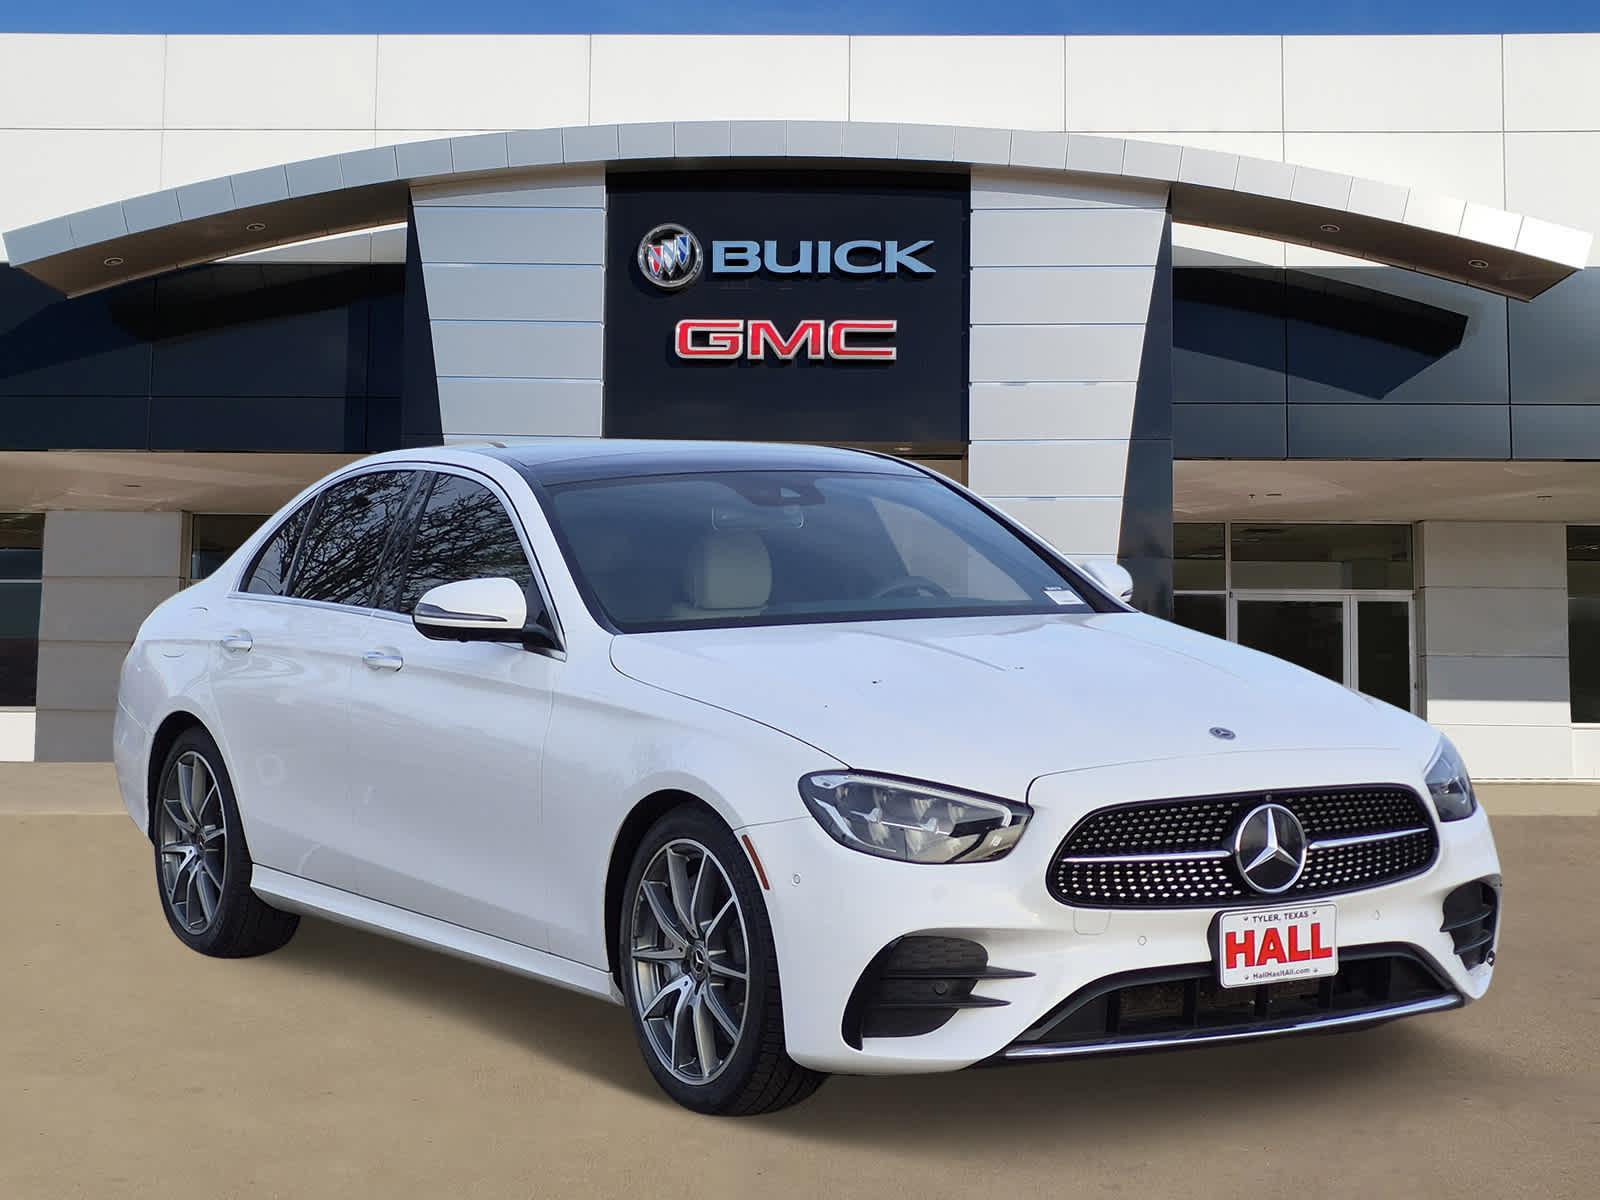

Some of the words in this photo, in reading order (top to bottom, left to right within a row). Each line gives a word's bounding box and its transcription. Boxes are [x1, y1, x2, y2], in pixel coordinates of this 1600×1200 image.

[712, 240, 937, 274] BUICK
[674, 319, 898, 361] GMC
[1284, 910, 1310, 920] TEXAS
[1225, 922, 1332, 969] HALL
